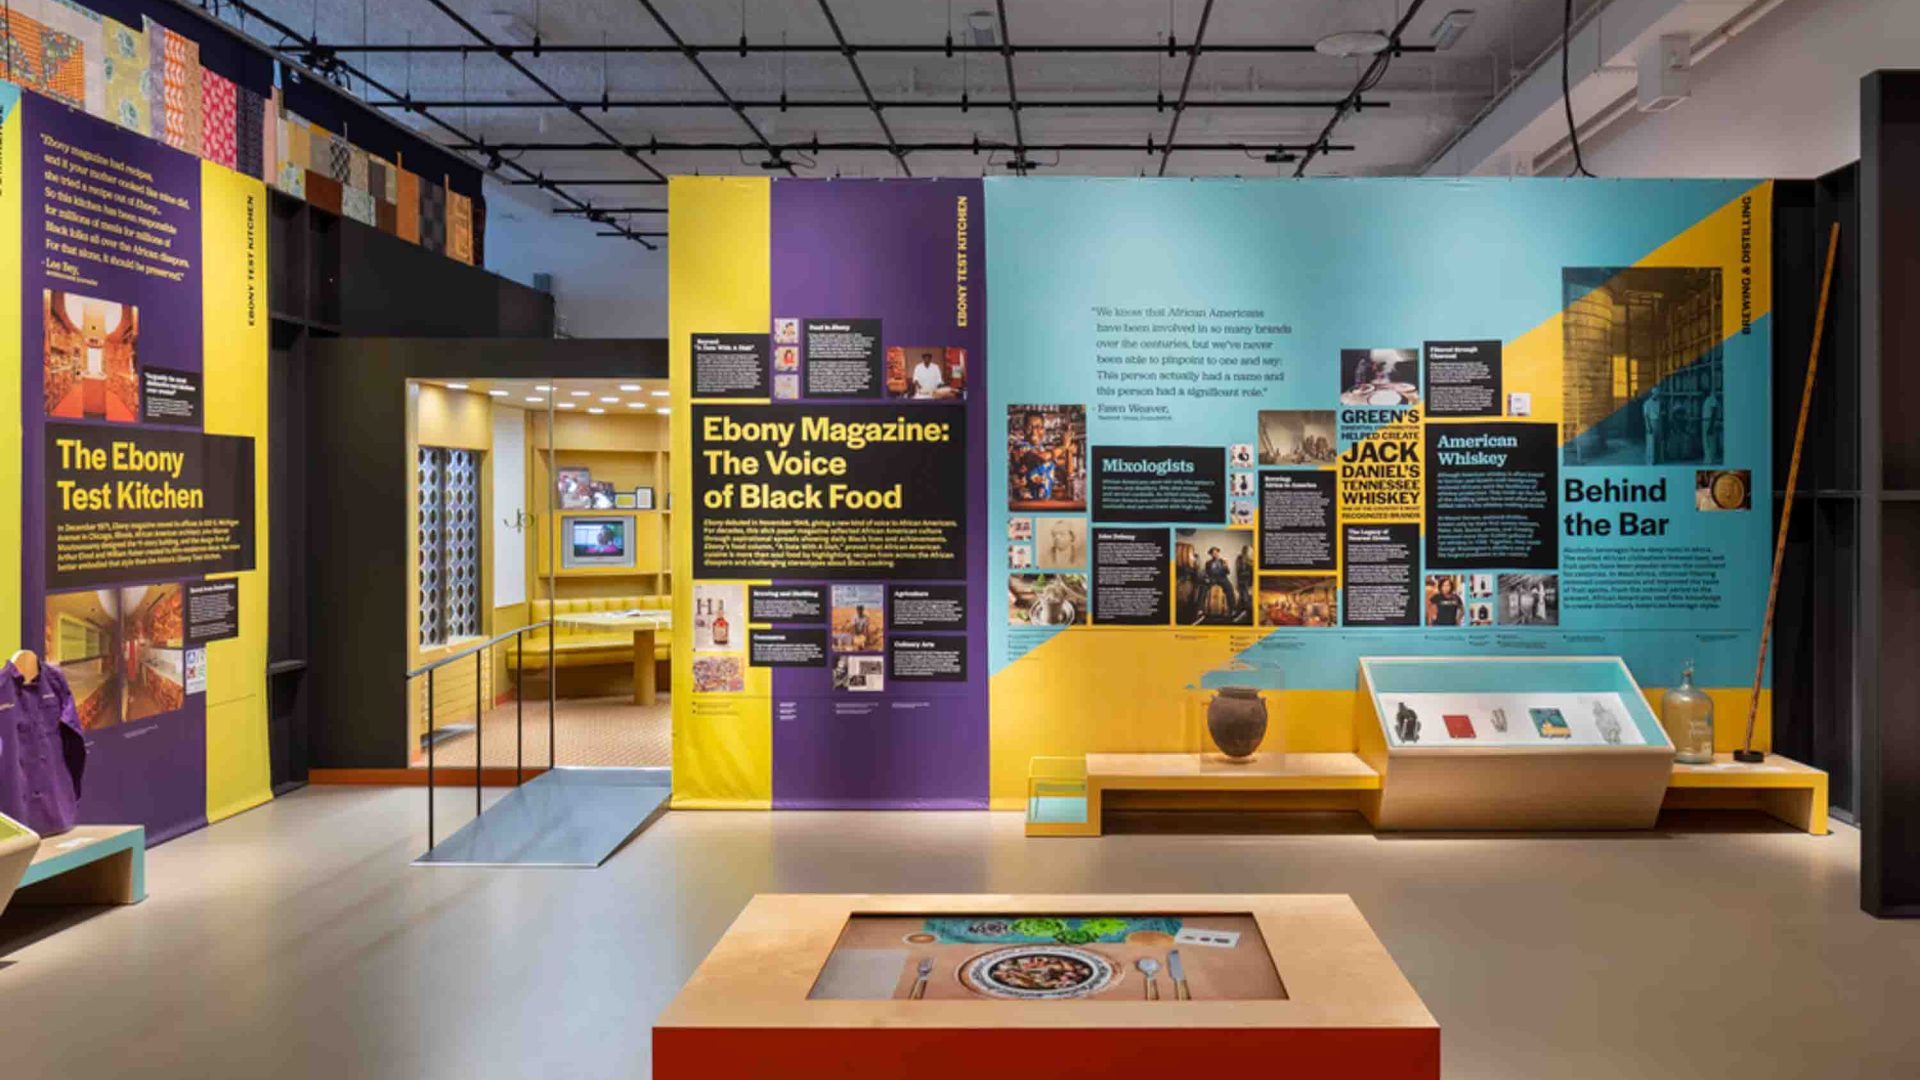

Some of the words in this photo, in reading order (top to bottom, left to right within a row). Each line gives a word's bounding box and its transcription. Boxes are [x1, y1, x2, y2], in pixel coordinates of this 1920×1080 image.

[957, 196, 968, 251] KITCHEN
[1741, 196, 1752, 263] DISTILLING
[957, 252, 968, 283] TEST
[1741, 266, 1752, 275] &
[957, 284, 968, 327] EBONY
[1741, 278, 1752, 335] BREWING
[1341, 409, 1420, 424] GREEN'S
[704, 416, 795, 447] Ebony
[802, 417, 949, 449] Magazine:
[1341, 432, 1380, 441] HELPED
[1381, 432, 1420, 441] CREATE
[1438, 434, 1517, 448] American
[56, 439, 107, 470] The
[113, 442, 184, 478] Ebony
[703, 450, 759, 475] The
[765, 451, 846, 475] Voice
[1342, 441, 1420, 463] JACK
[1438, 452, 1507, 467] Whiskey
[1103, 459, 1194, 476] Mixologists
[1342, 464, 1420, 478] DANIEL'S
[57, 481, 111, 510] Test
[118, 481, 203, 509] Kitchen
[704, 484, 734, 508] of
[741, 484, 822, 508] Black
[830, 484, 901, 508] Food
[1342, 480, 1420, 490] TENNESSEE
[1565, 477, 1667, 502] Behind
[1342, 491, 1420, 505] WHISKEY
[1564, 512, 1611, 536] the
[1620, 512, 1669, 536] Bar
[697, 598, 713, 615] H
